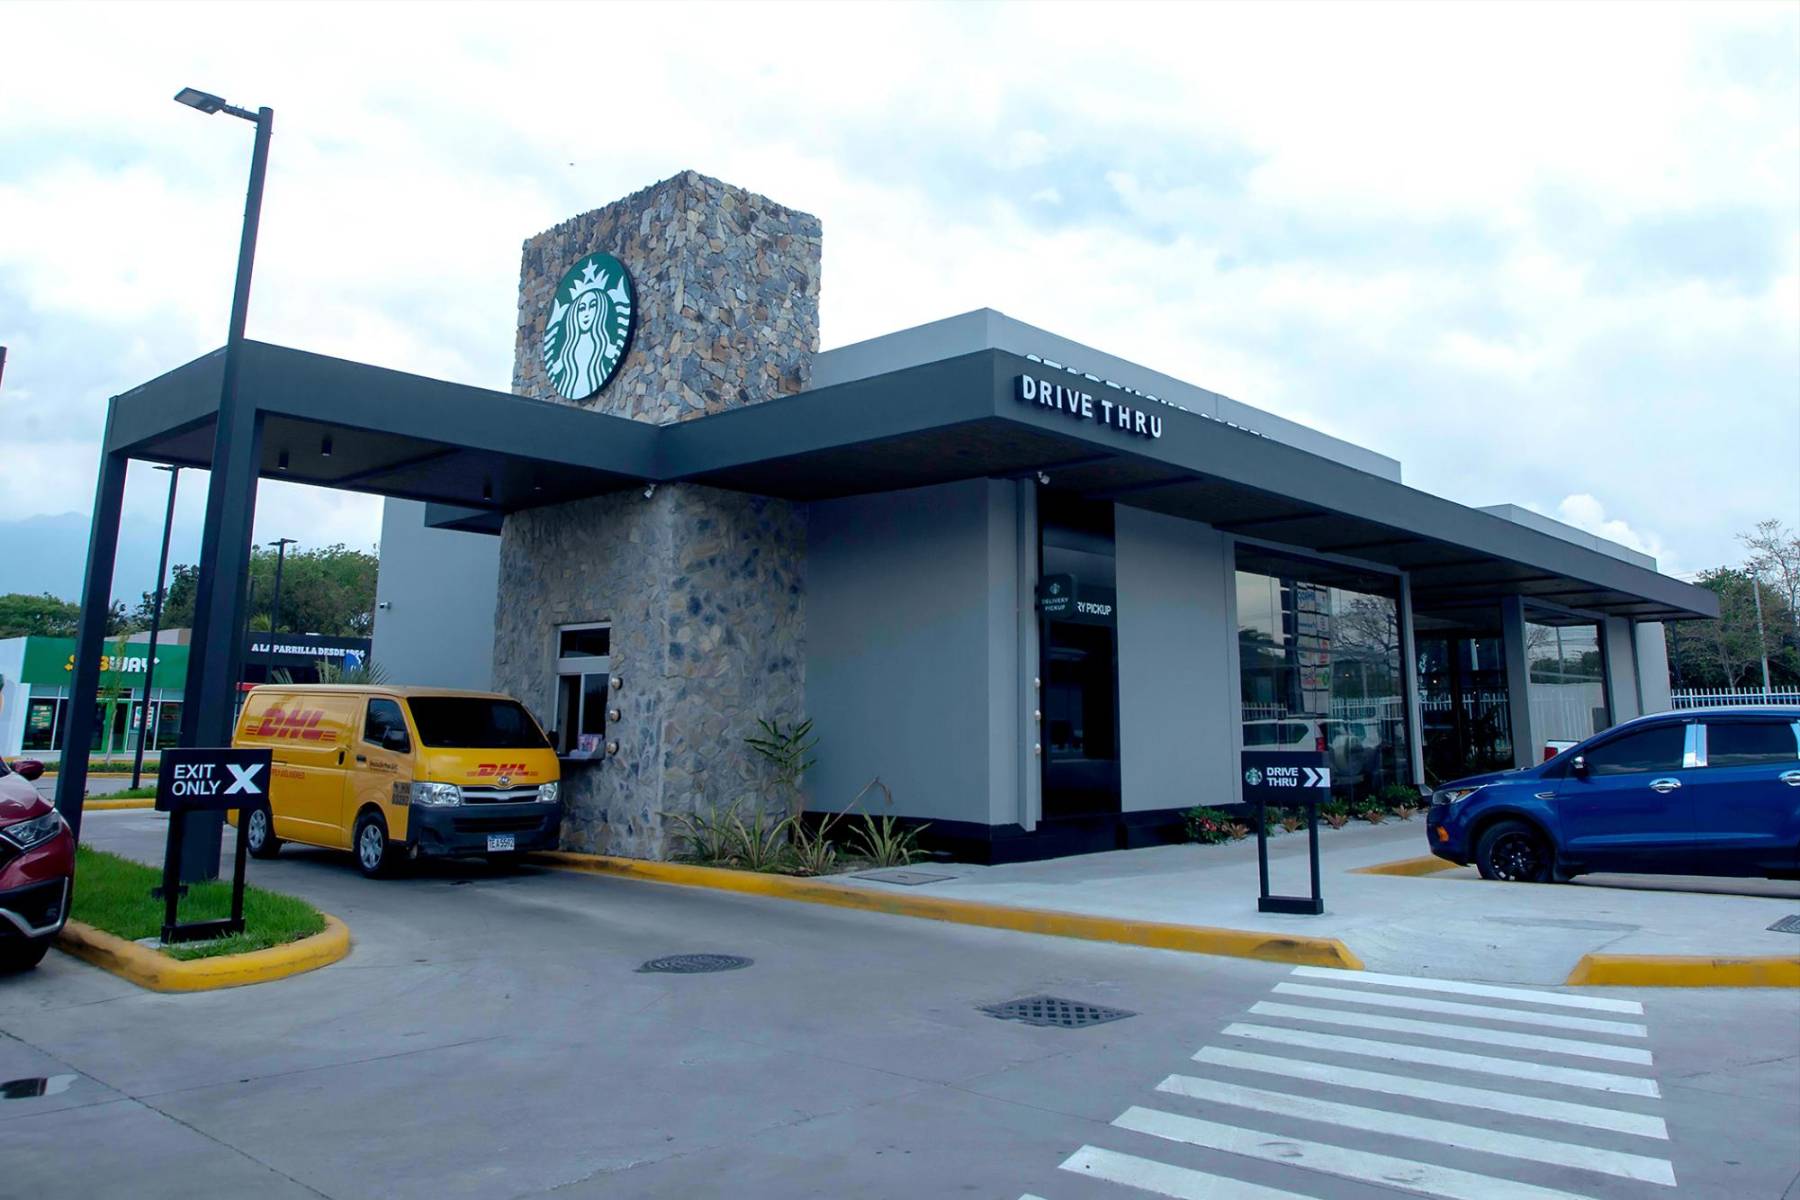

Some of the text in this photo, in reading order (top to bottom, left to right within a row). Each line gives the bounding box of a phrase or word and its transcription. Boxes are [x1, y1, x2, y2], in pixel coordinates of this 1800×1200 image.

[1018, 374, 1094, 418] DRIVE
[1100, 399, 1162, 438] THRU
[1086, 603, 1112, 615] PICKUP
[272, 645, 317, 655] PARRILLA
[317, 647, 345, 657] DESDE
[64, 655, 160, 673] SBWAY
[256, 707, 324, 740] DHL
[174, 763, 216, 779] EXIT
[477, 763, 530, 777] DHL
[1266, 767, 1299, 777] DRIVE
[171, 780, 221, 796] ONLY
[1266, 777, 1297, 788] THRU
